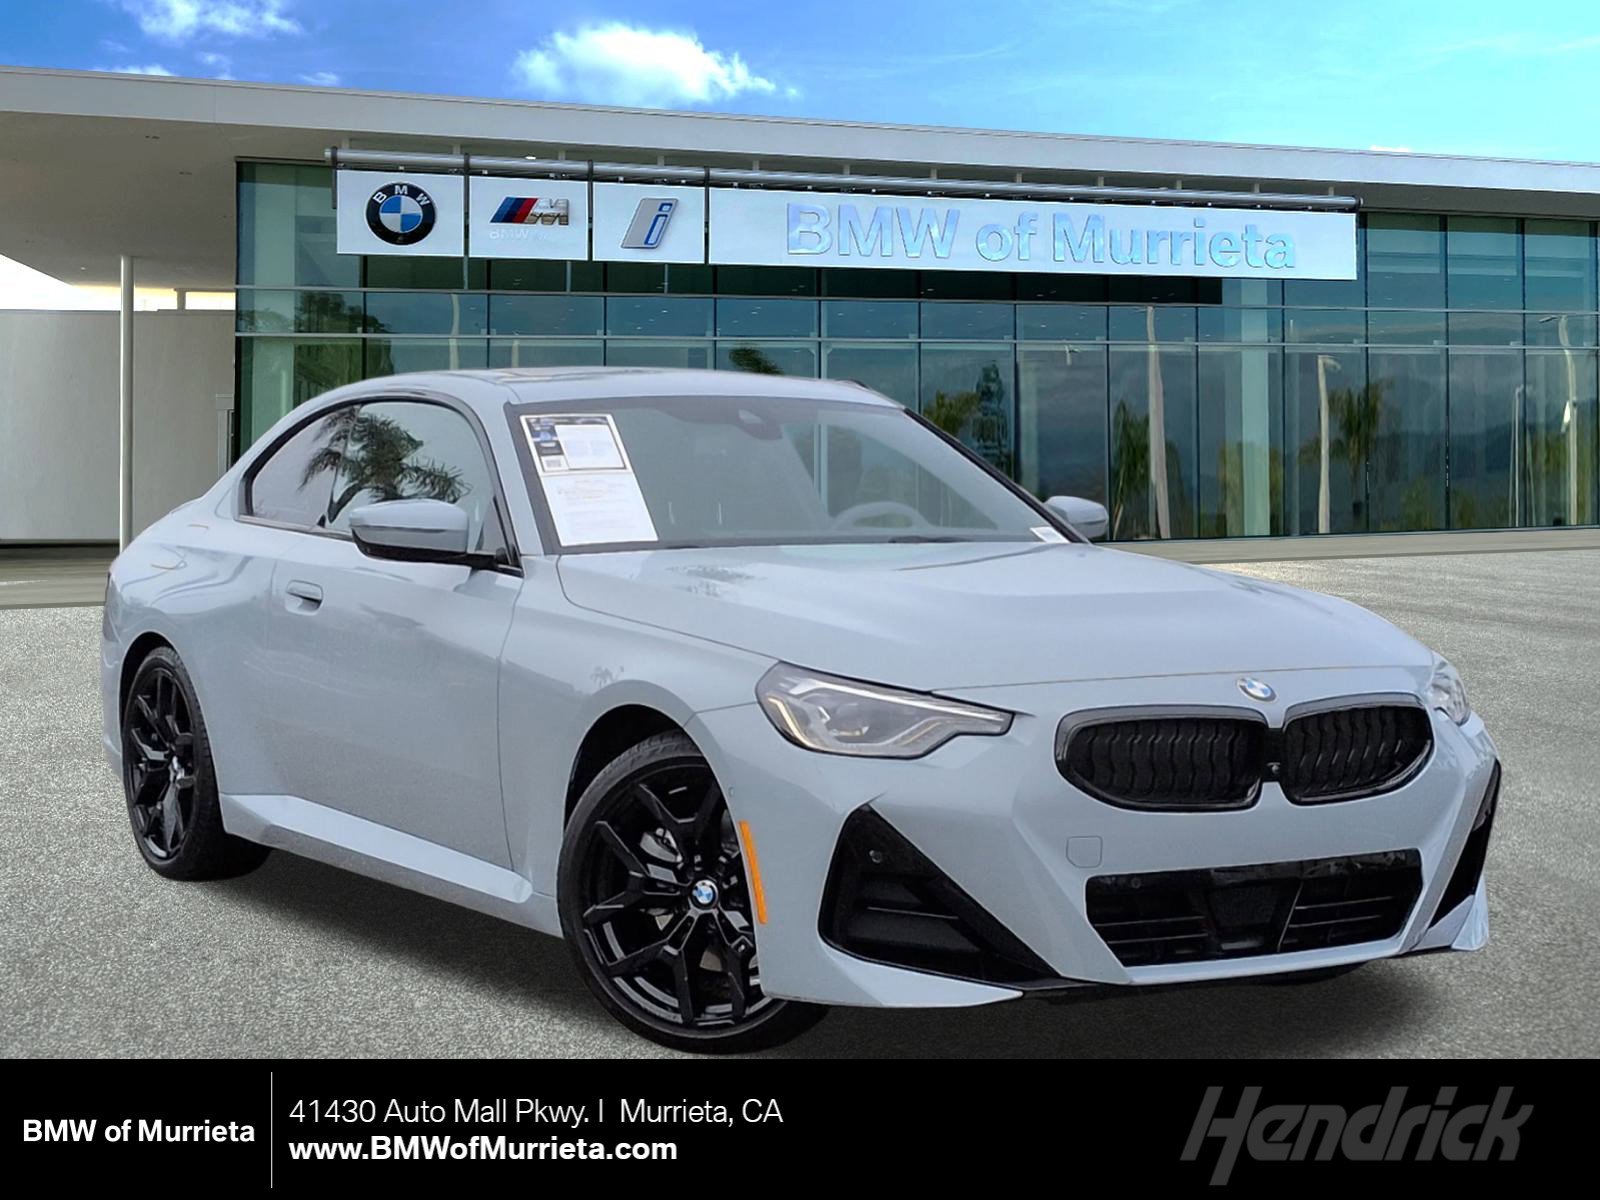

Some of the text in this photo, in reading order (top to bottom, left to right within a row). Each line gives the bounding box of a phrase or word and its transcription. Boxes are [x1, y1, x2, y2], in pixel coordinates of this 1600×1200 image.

[373, 185, 430, 206] BMW
[787, 203, 1295, 269] BMW of Murrieta
